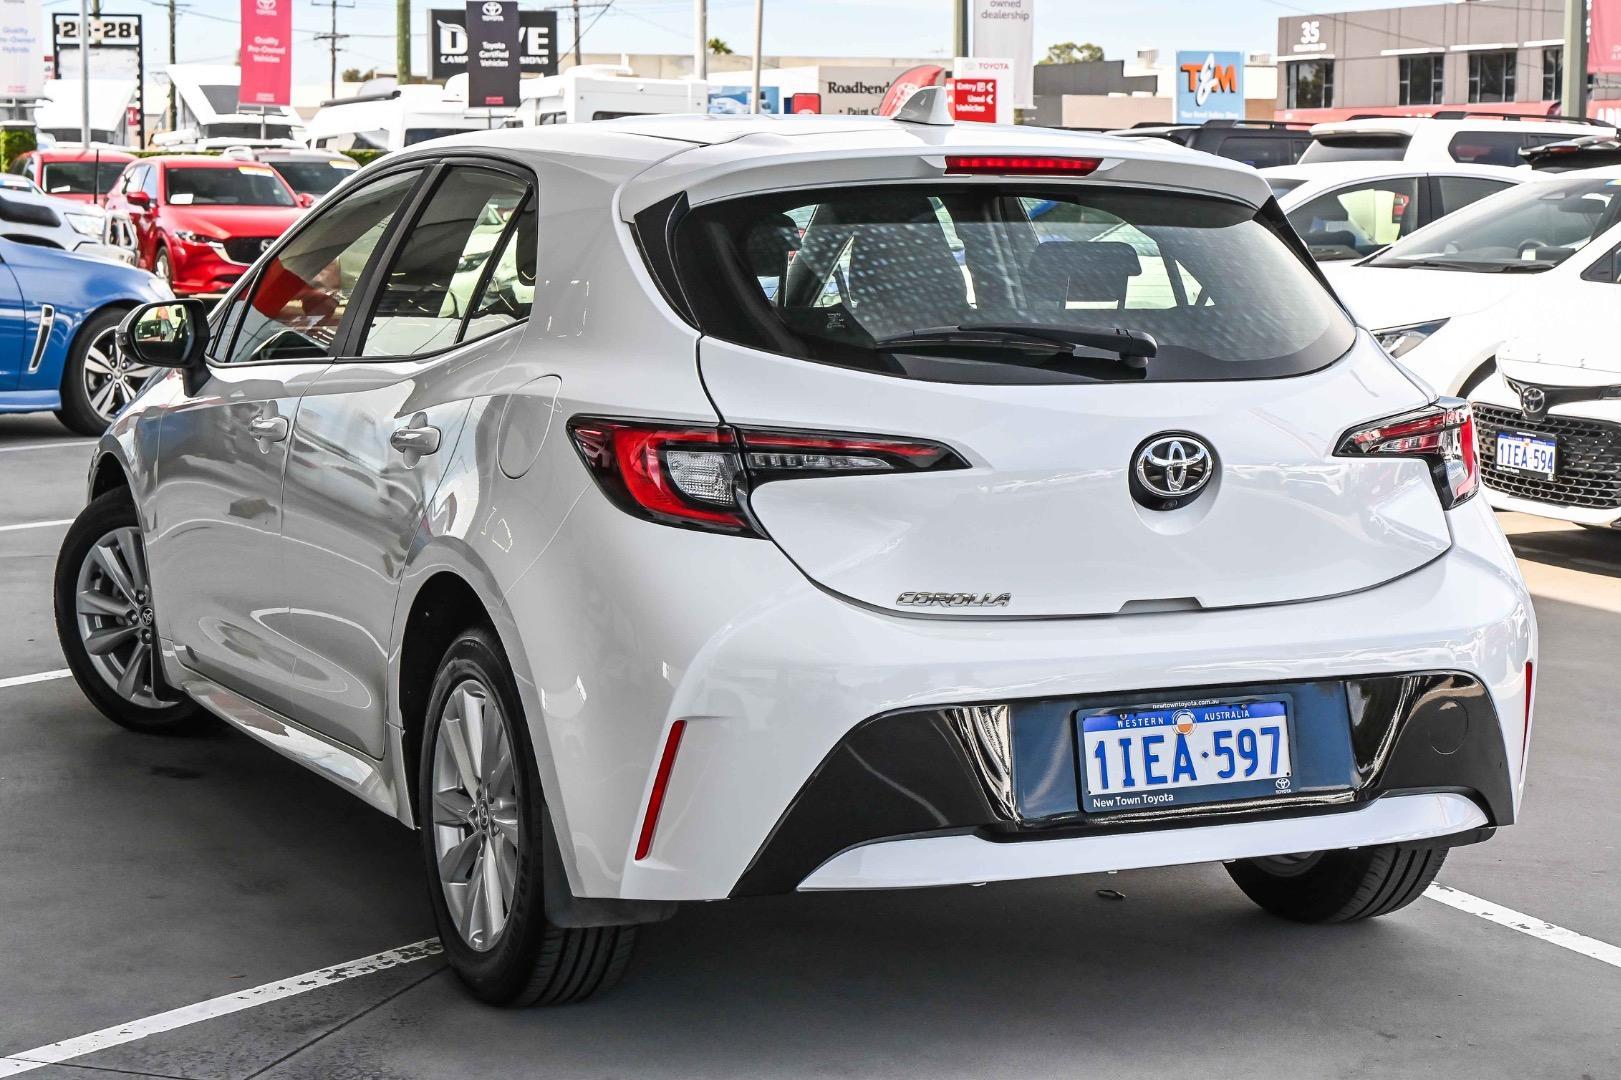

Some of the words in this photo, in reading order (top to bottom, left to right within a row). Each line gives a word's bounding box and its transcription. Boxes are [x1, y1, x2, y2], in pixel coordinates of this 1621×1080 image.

[981, 10, 1030, 21] dealership
[1301, 21, 1319, 44] 35
[482, 41, 506, 50] Toyota
[479, 50, 510, 58] Certified
[480, 59, 509, 67] Vehicles
[957, 82, 977, 92] Entry
[967, 95, 985, 103] Used
[956, 104, 985, 112] Vehicles
[896, 591, 1012, 608] COROLLA
[1152, 700, 1220, 709] newtowntoyota.com.au
[1117, 717, 1164, 728] WESTERN
[1204, 710, 1250, 721] AUSTRALIA
[1093, 797, 1114, 808] New
[1115, 795, 1141, 806] Town
[1142, 793, 1174, 804] Toyota
